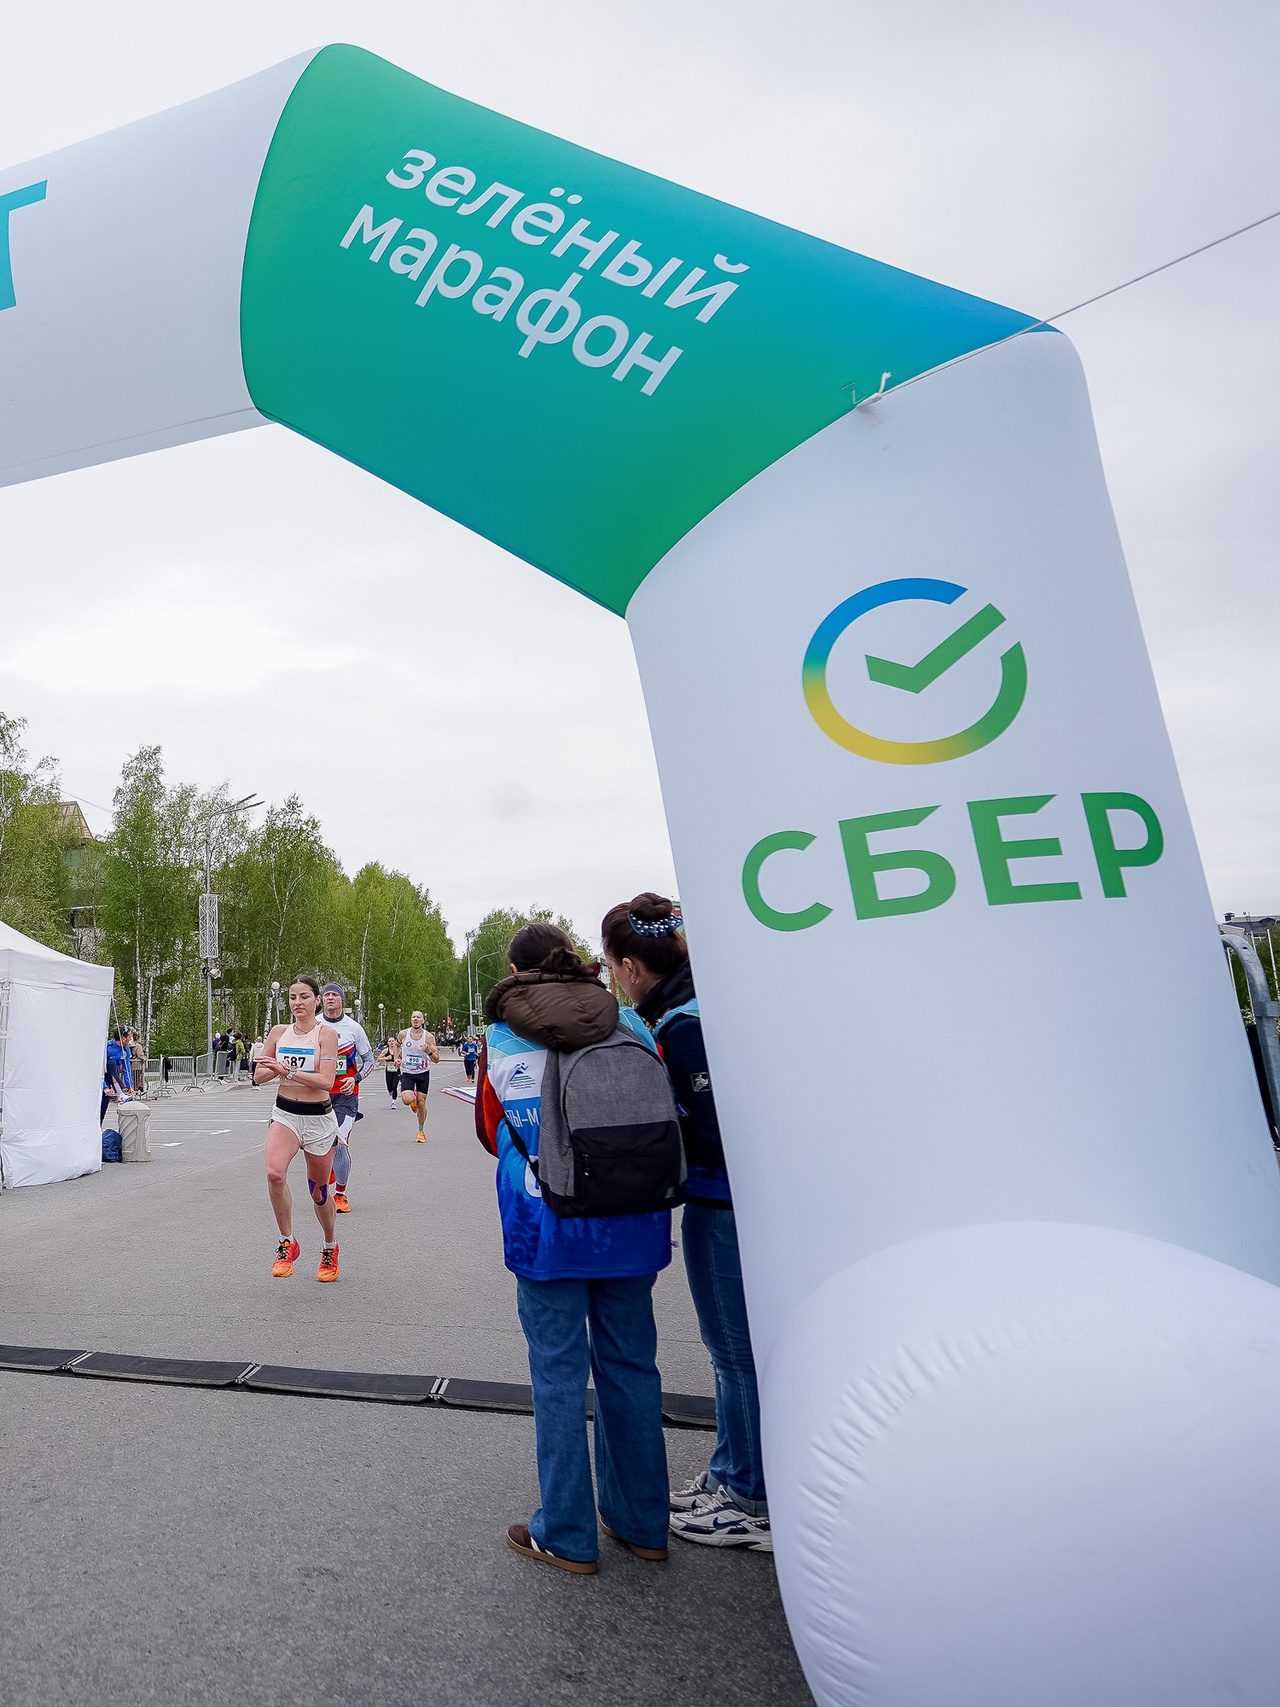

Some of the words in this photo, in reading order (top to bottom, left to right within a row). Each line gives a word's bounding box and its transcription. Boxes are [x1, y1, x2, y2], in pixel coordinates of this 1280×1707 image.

[340, 205, 683, 396] марафон
[386, 150, 749, 322] зелёный
[742, 792, 1164, 932] СБЕР
[284, 1056, 306, 1068] 587
